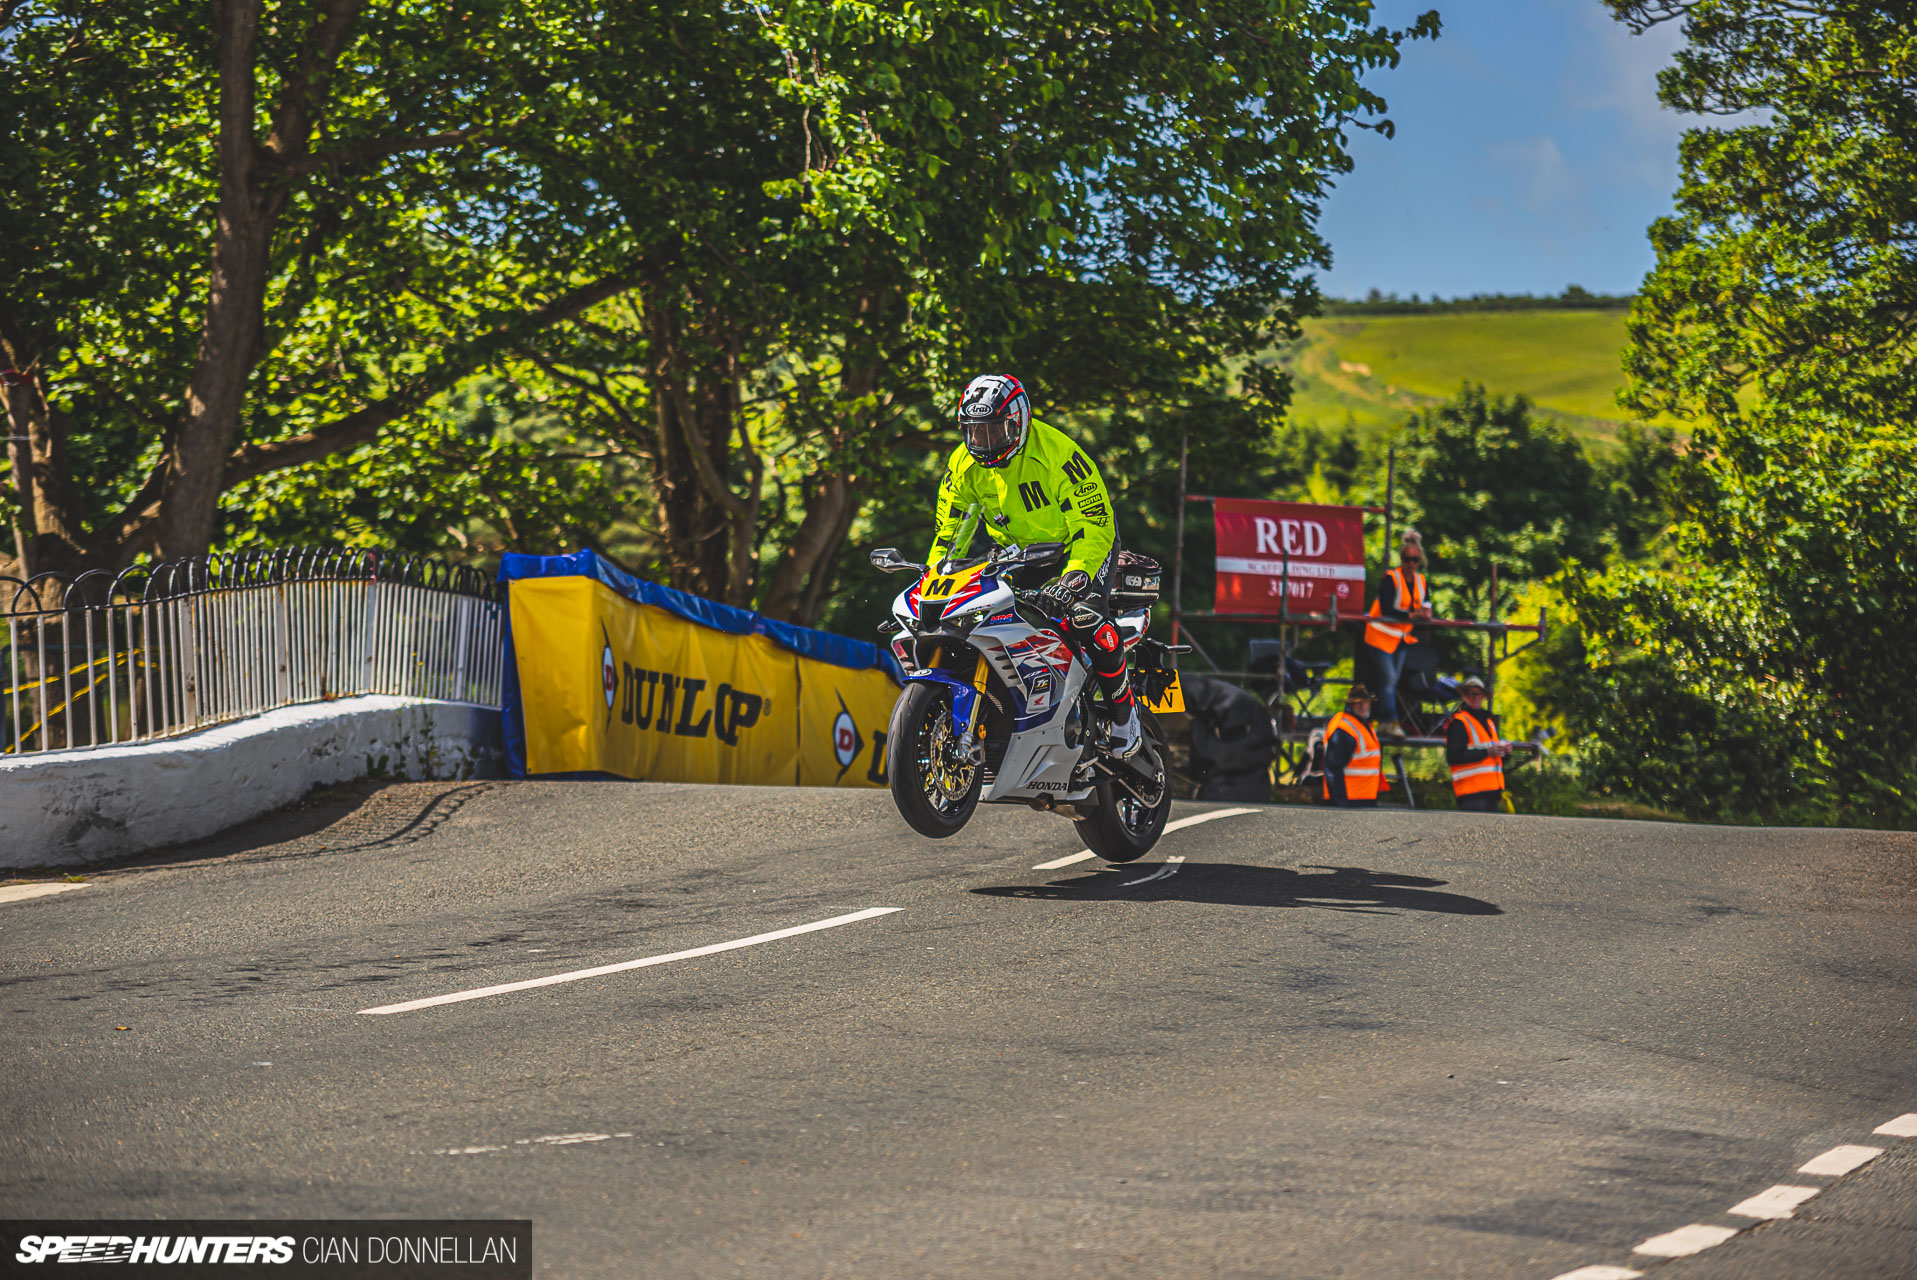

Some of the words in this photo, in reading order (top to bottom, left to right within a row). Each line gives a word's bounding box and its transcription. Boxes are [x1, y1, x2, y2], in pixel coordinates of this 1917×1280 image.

[1061, 450, 1093, 485] M
[1018, 481, 1051, 513] M
[1077, 483, 1096, 495] Arai
[1079, 494, 1102, 508] MOTUL
[1254, 516, 1327, 557] RED
[925, 578, 956, 597] M
[621, 661, 763, 746] DUNLOP
[1026, 781, 1068, 791] HONDA
